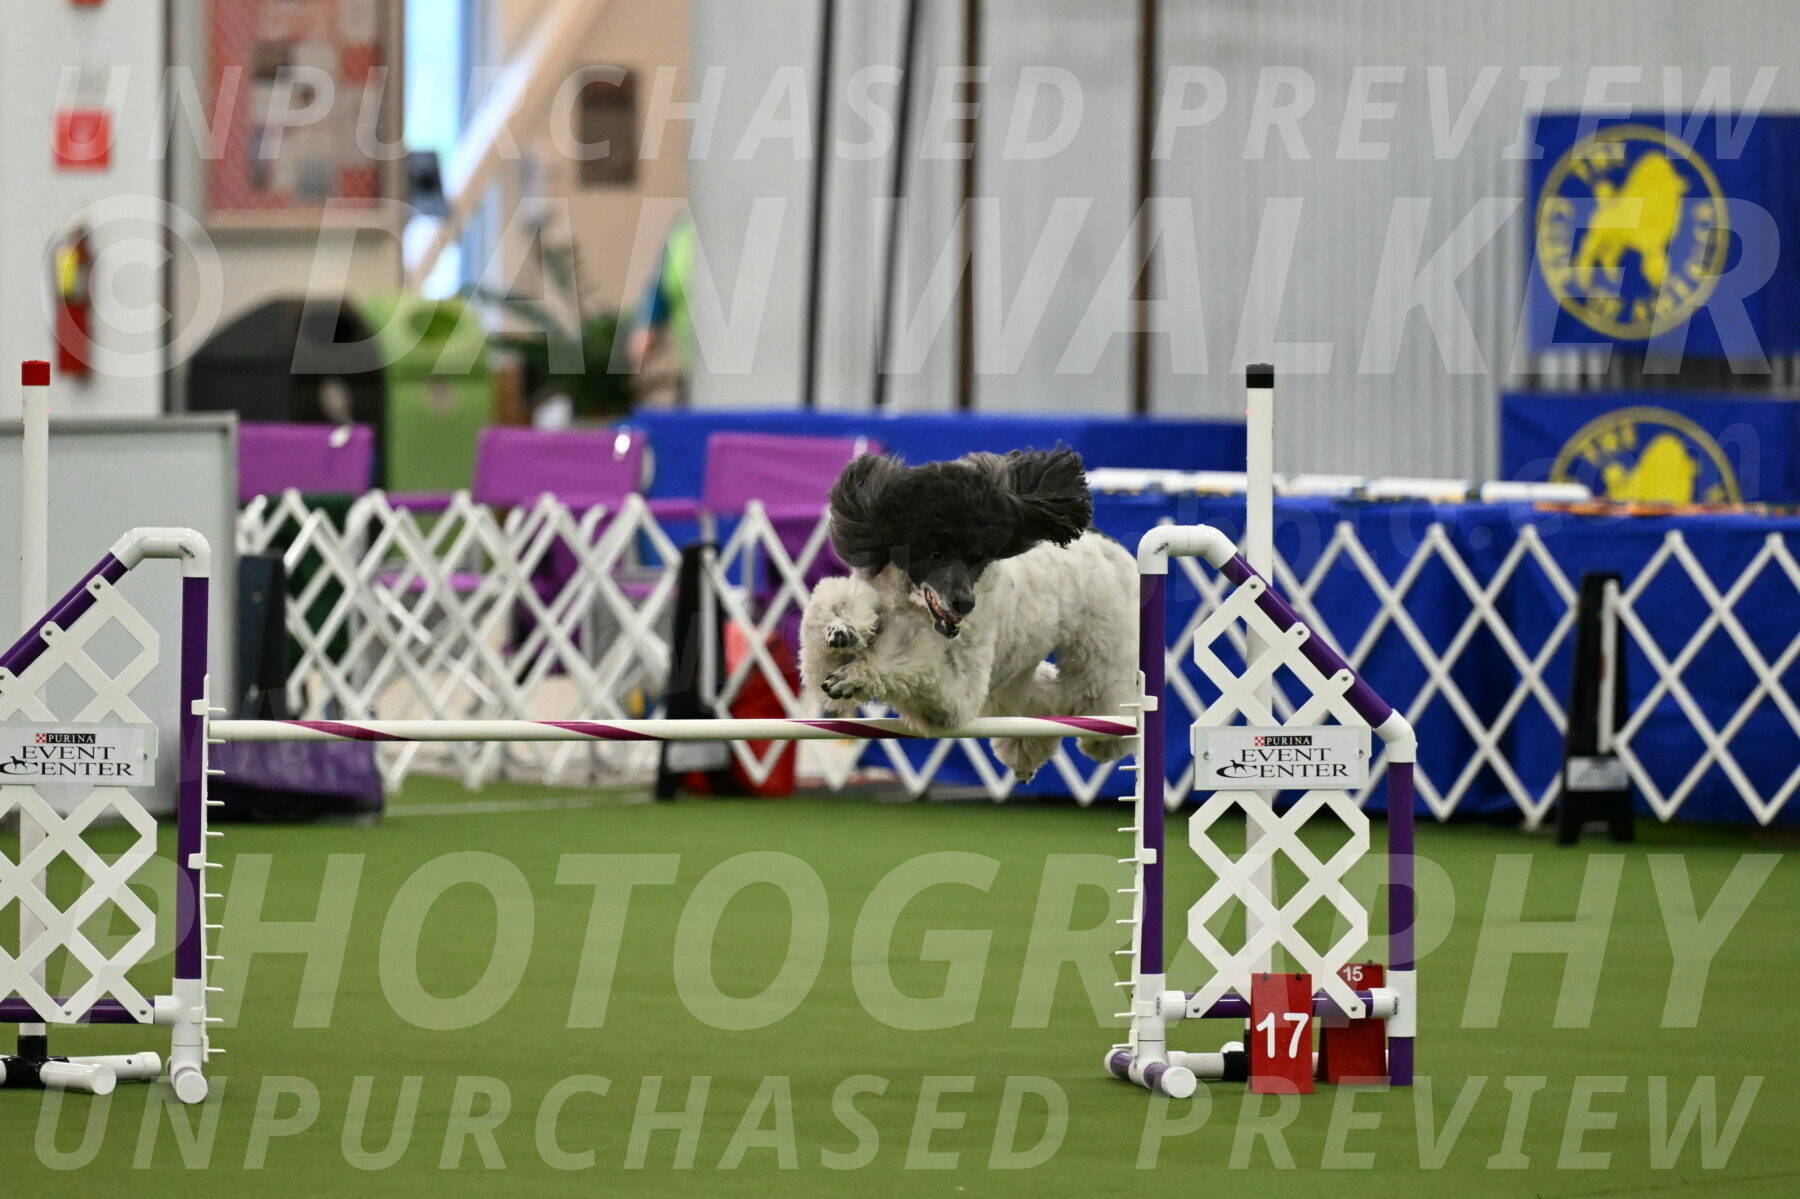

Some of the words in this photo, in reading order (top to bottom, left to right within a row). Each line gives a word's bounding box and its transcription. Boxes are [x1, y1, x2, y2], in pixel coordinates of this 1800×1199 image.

[48, 733, 95, 744] PURINA
[1266, 736, 1311, 746] PURINA
[21, 745, 116, 760] EVENT
[1241, 748, 1331, 762] EVENT
[0, 760, 134, 776] CENTER
[1216, 763, 1350, 778] CENTER
[1343, 966, 1364, 982] 15
[1256, 1012, 1309, 1059] 17
